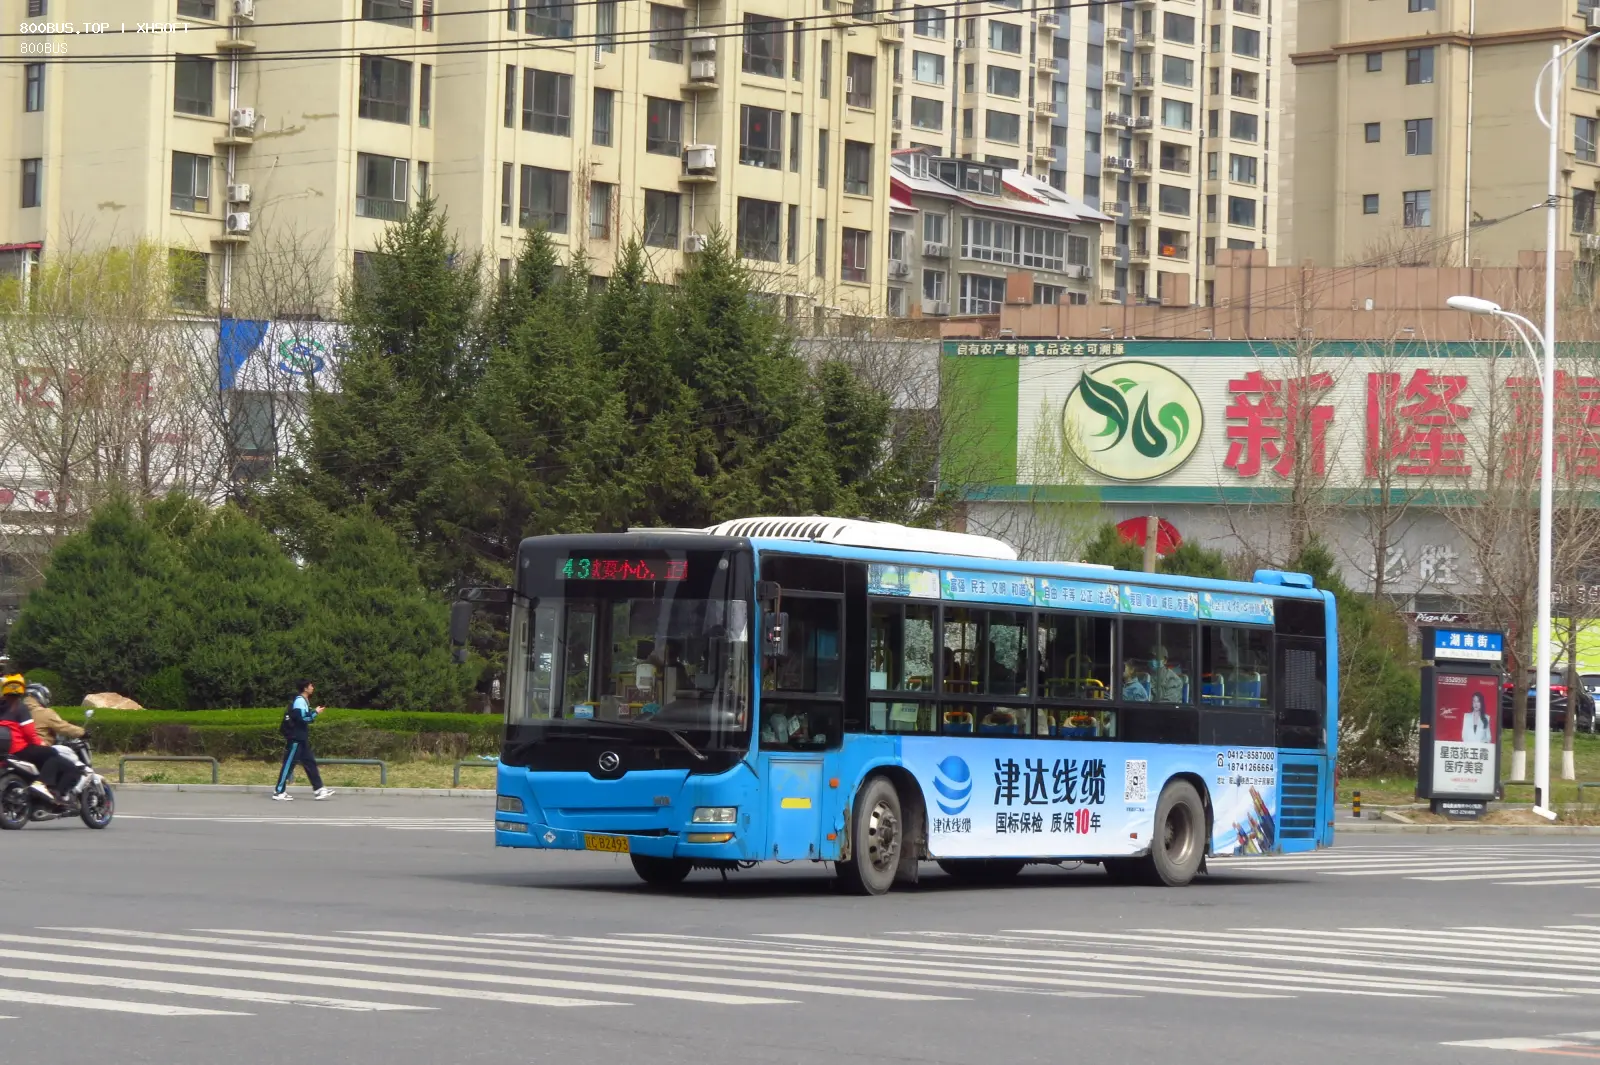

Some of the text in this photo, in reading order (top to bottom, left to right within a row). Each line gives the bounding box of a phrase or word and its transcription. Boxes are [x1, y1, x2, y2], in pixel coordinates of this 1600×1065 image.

[957, 343, 1125, 355] 自有农产基地 食品安全可溯源
[562, 558, 590, 579] 43
[950, 578, 965, 593] 富强
[971, 579, 986, 594] 民主
[991, 580, 1006, 595] 文明
[1011, 582, 1027, 597] 和谐
[1044, 586, 1112, 605] 自由 平等 公正 法治
[1415, 613, 1458, 622] Pizza Hut
[1449, 633, 1488, 648] 湖南街
[1227, 750, 1275, 760] 0412-8587000
[1440, 746, 1489, 761] 星范张玉霞
[1227, 762, 1274, 772] 18741266664
[1444, 760, 1484, 775] 医疗美容
[993, 758, 1107, 806] 津达线缆
[933, 817, 972, 833] 津达线缆
[1050, 808, 1102, 835] 质保10年
